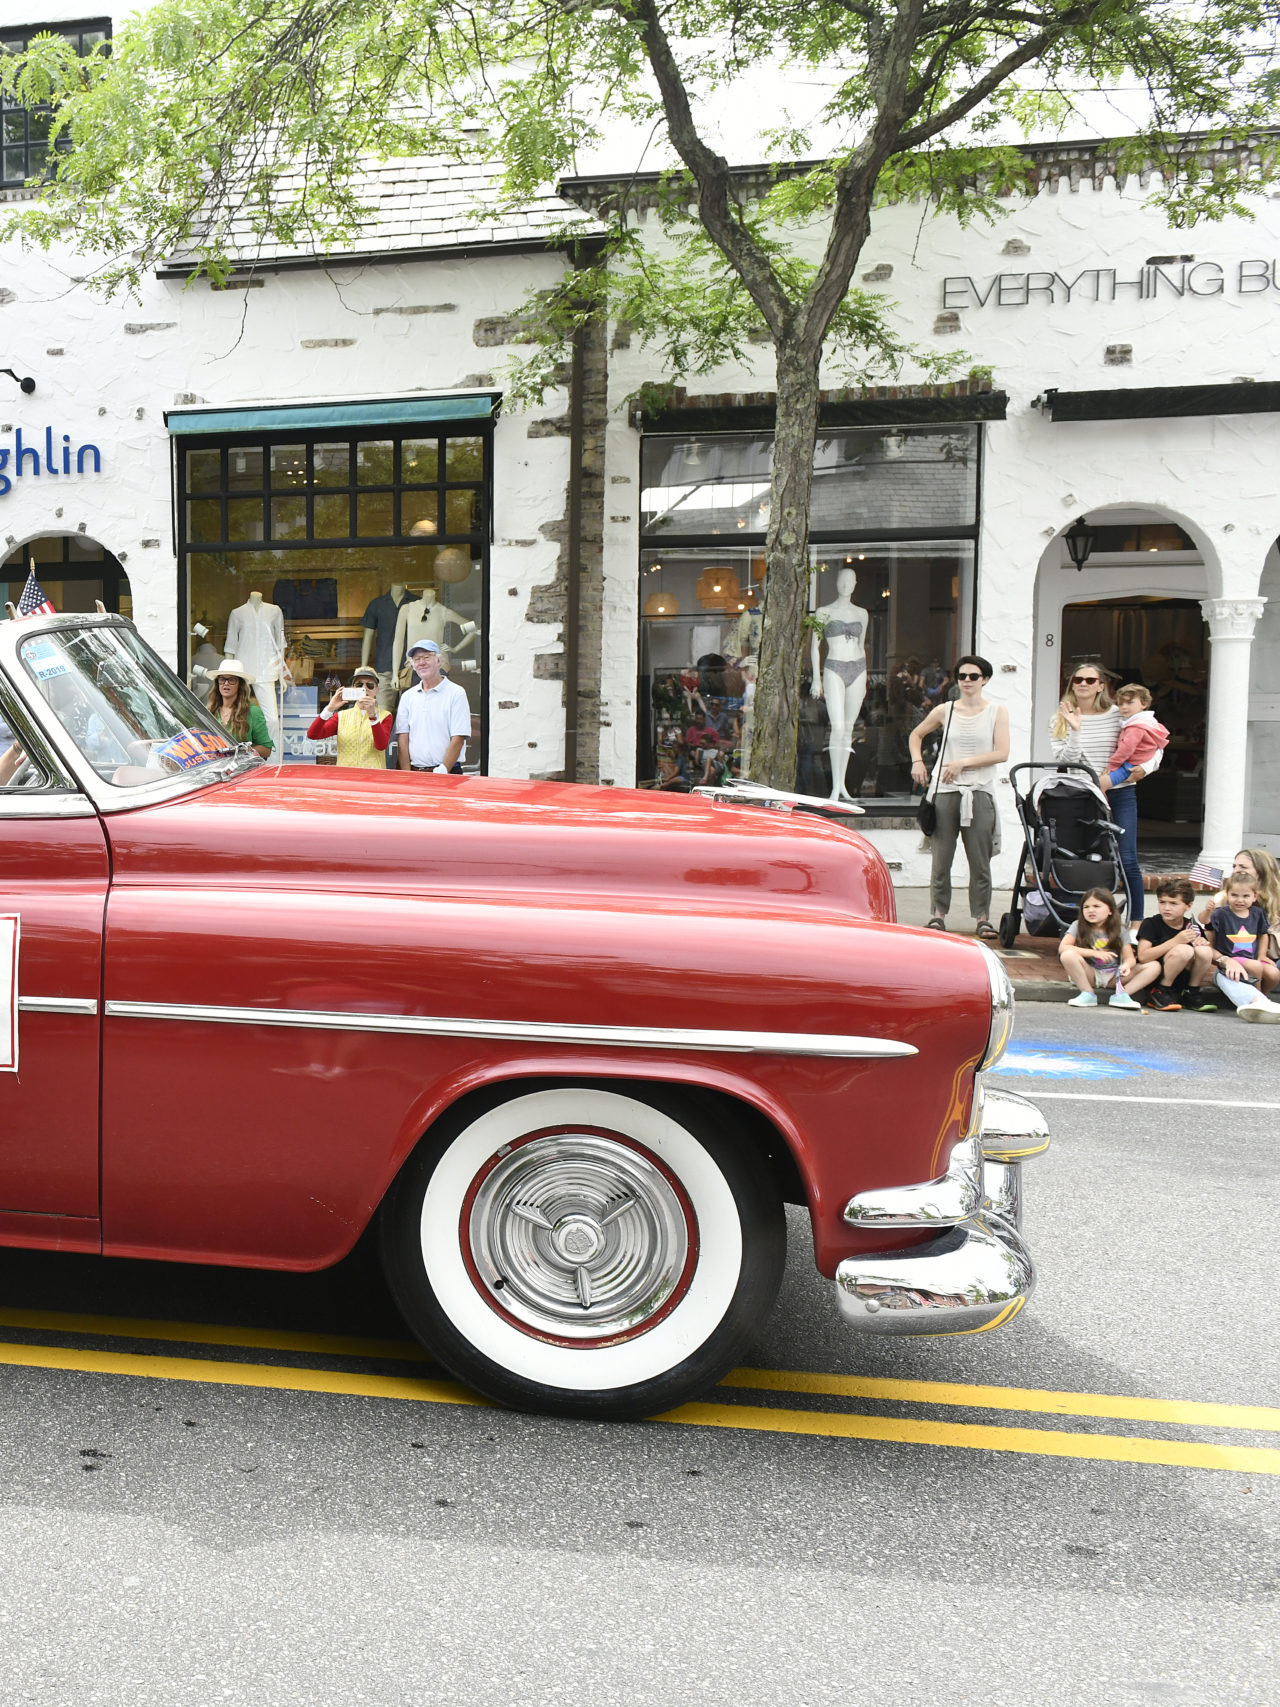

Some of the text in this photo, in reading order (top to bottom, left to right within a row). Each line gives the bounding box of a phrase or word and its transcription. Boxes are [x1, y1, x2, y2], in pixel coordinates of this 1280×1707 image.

[943, 258, 1280, 310] EVERYTHING B
[1045, 633, 1054, 647] 8
